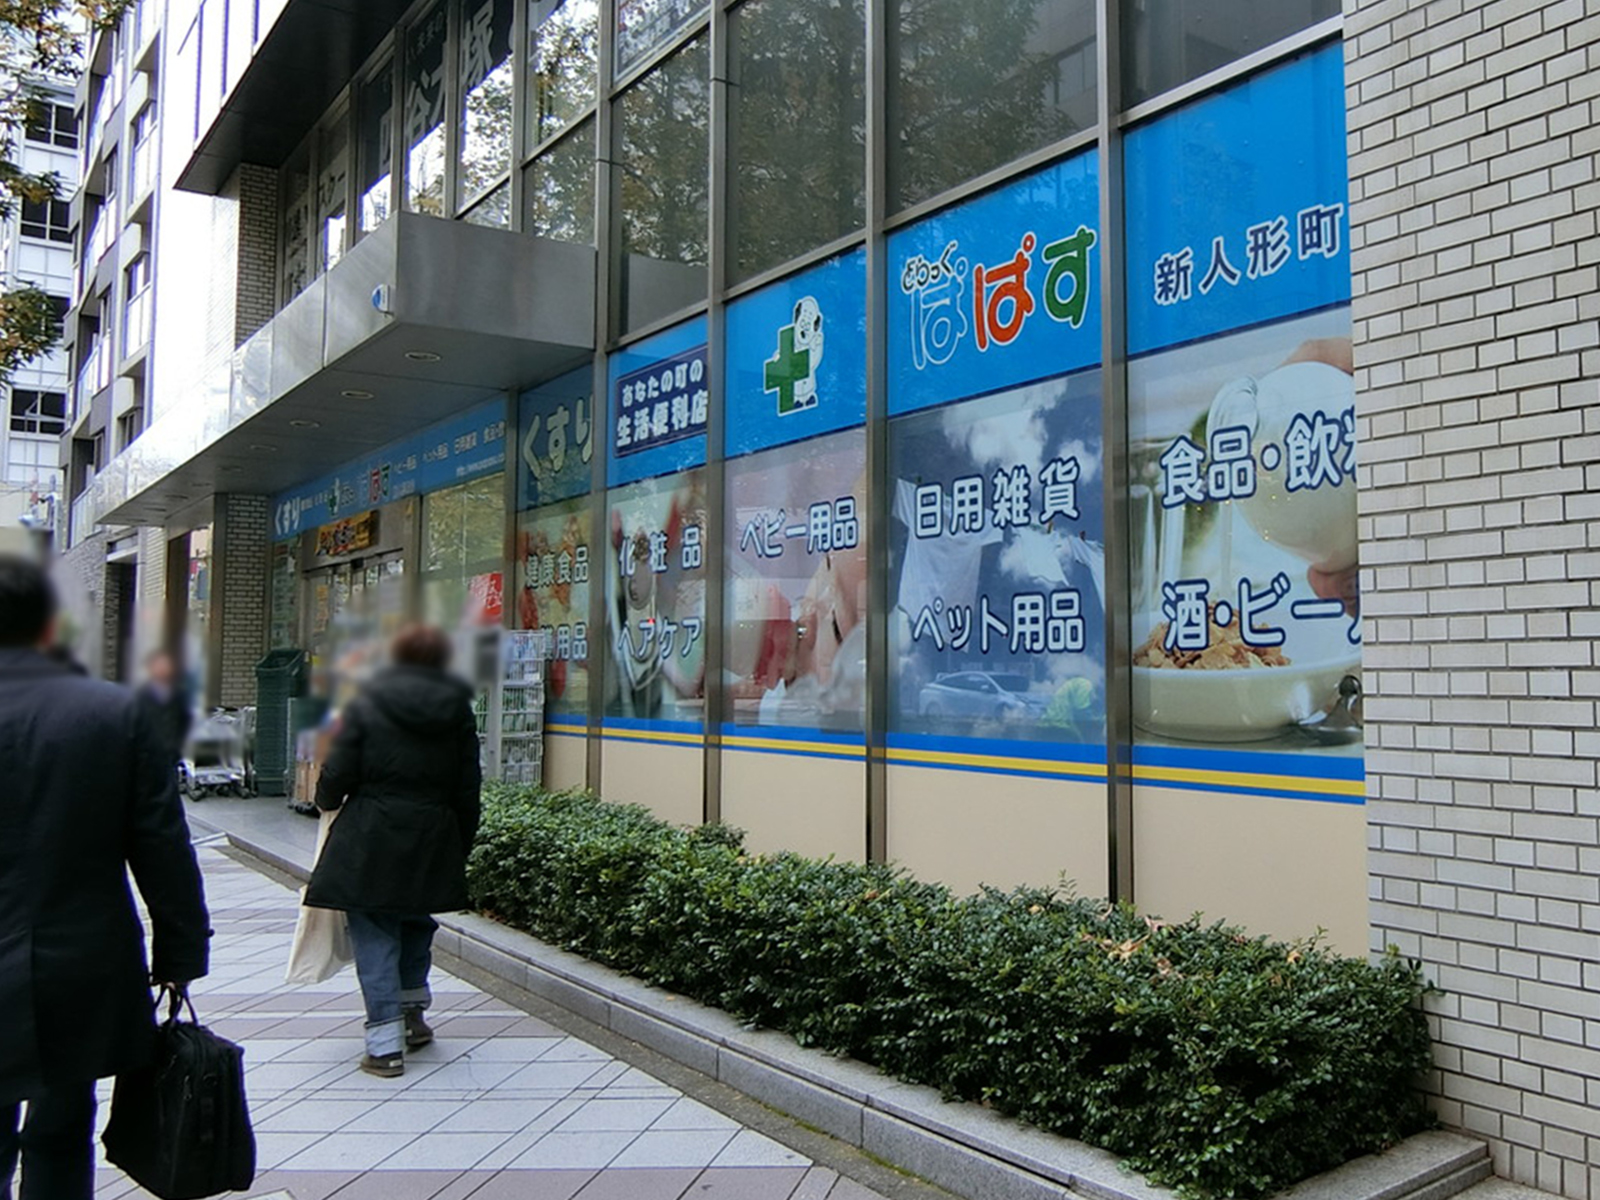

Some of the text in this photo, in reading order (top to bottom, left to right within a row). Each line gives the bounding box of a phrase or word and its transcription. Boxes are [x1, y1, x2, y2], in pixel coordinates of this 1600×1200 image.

[1154, 203, 1344, 306] 新人形町
[911, 225, 1097, 370] ぱぱす
[622, 359, 703, 408] あなたの町の
[523, 388, 593, 478] くすり
[616, 389, 708, 447] 生活便利店
[740, 497, 858, 558] ベビー用品
[914, 456, 1080, 540] 日用雑貨
[618, 526, 702, 577] 化粧品
[618, 616, 701, 658] ヘアケア
[912, 587, 1085, 654] ペット用品
[1162, 571, 1362, 652] 酒・ビー
